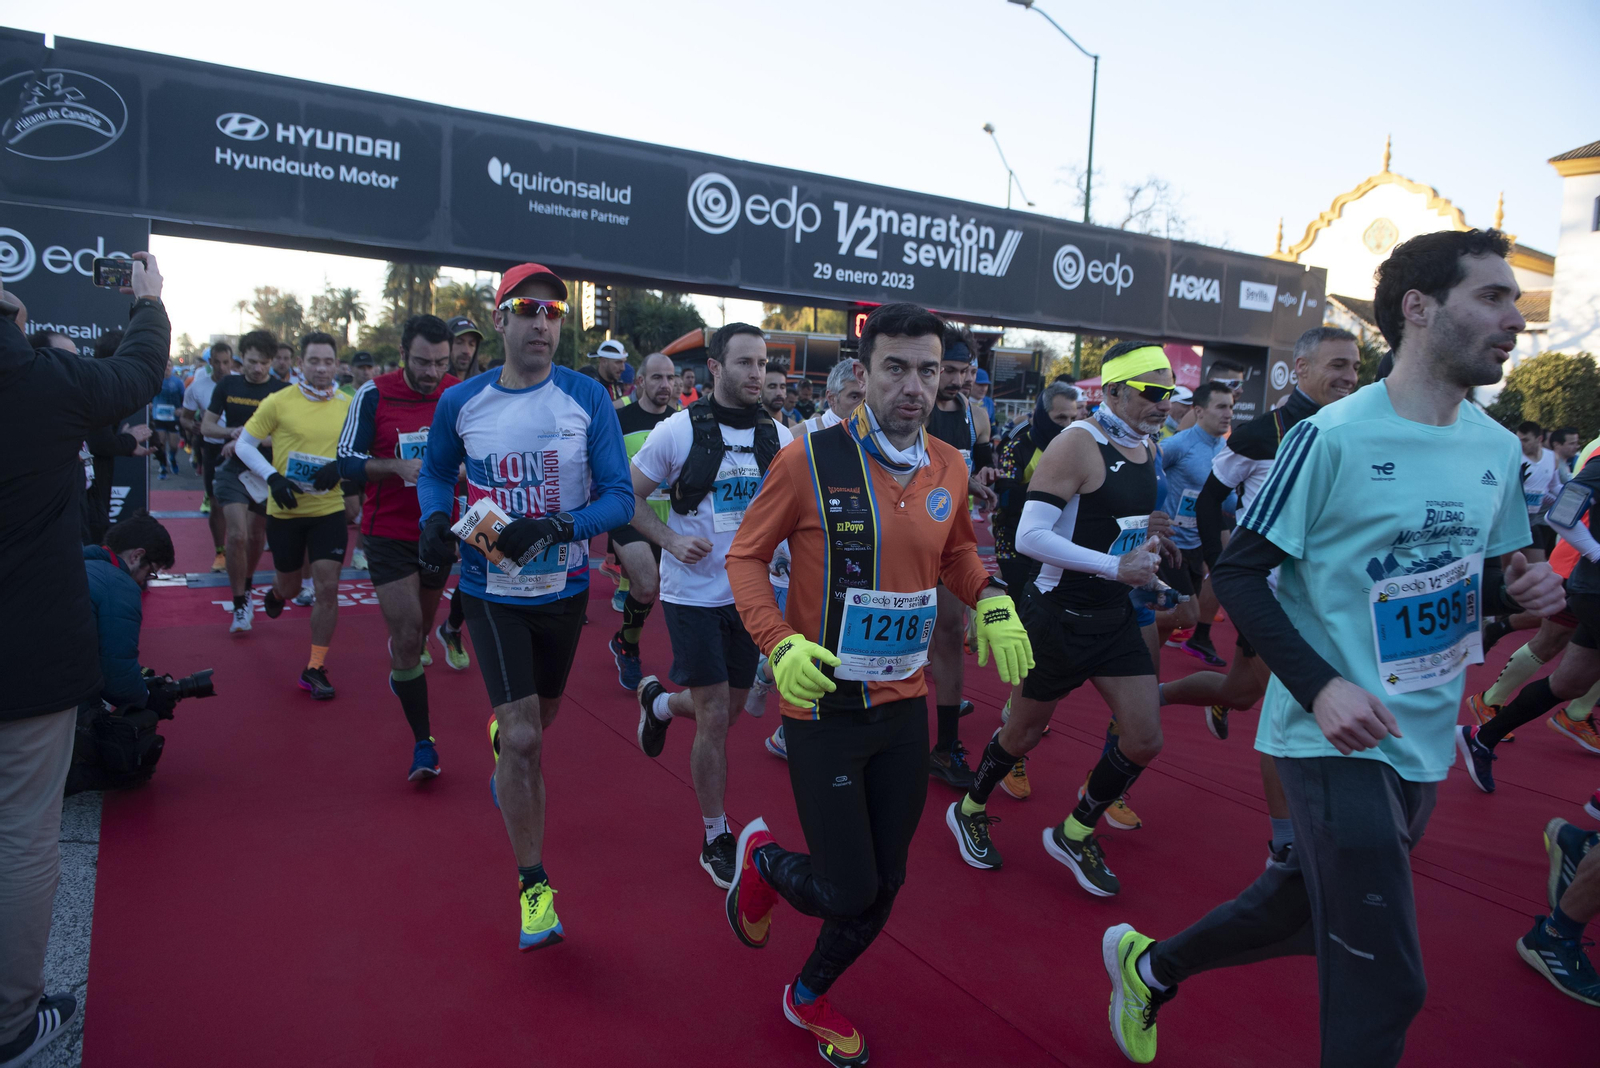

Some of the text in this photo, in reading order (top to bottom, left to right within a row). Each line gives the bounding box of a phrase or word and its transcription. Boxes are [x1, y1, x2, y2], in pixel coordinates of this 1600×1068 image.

[47, 107, 61, 120] de
[276, 122, 401, 162] HYUNDAI
[214, 146, 399, 190] Hyundauto Motor
[508, 169, 632, 206] quirónsalud
[528, 199, 631, 227] Healthcare Partner
[744, 185, 823, 244] edp
[871, 206, 997, 251] maratón
[42, 235, 132, 288] ed
[902, 239, 1002, 278] sevilla
[813, 261, 915, 291] 29 enero 2023
[1086, 252, 1135, 297] edp
[1168, 273, 1221, 304] HOKA
[486, 451, 545, 486] LON
[543, 449, 560, 512] MARATHON
[1481, 479, 1498, 487] adidas
[495, 484, 547, 516] DON
[722, 481, 757, 502] 2443
[836, 521, 864, 534] El Poyo
[1421, 508, 1466, 530] BILBAO
[1401, 579, 1426, 592] edp
[872, 595, 891, 607] edp
[1395, 590, 1462, 639] 1595
[861, 613, 919, 642] 1218
[841, 645, 869, 654] Francisco
[887, 655, 902, 666] edp
